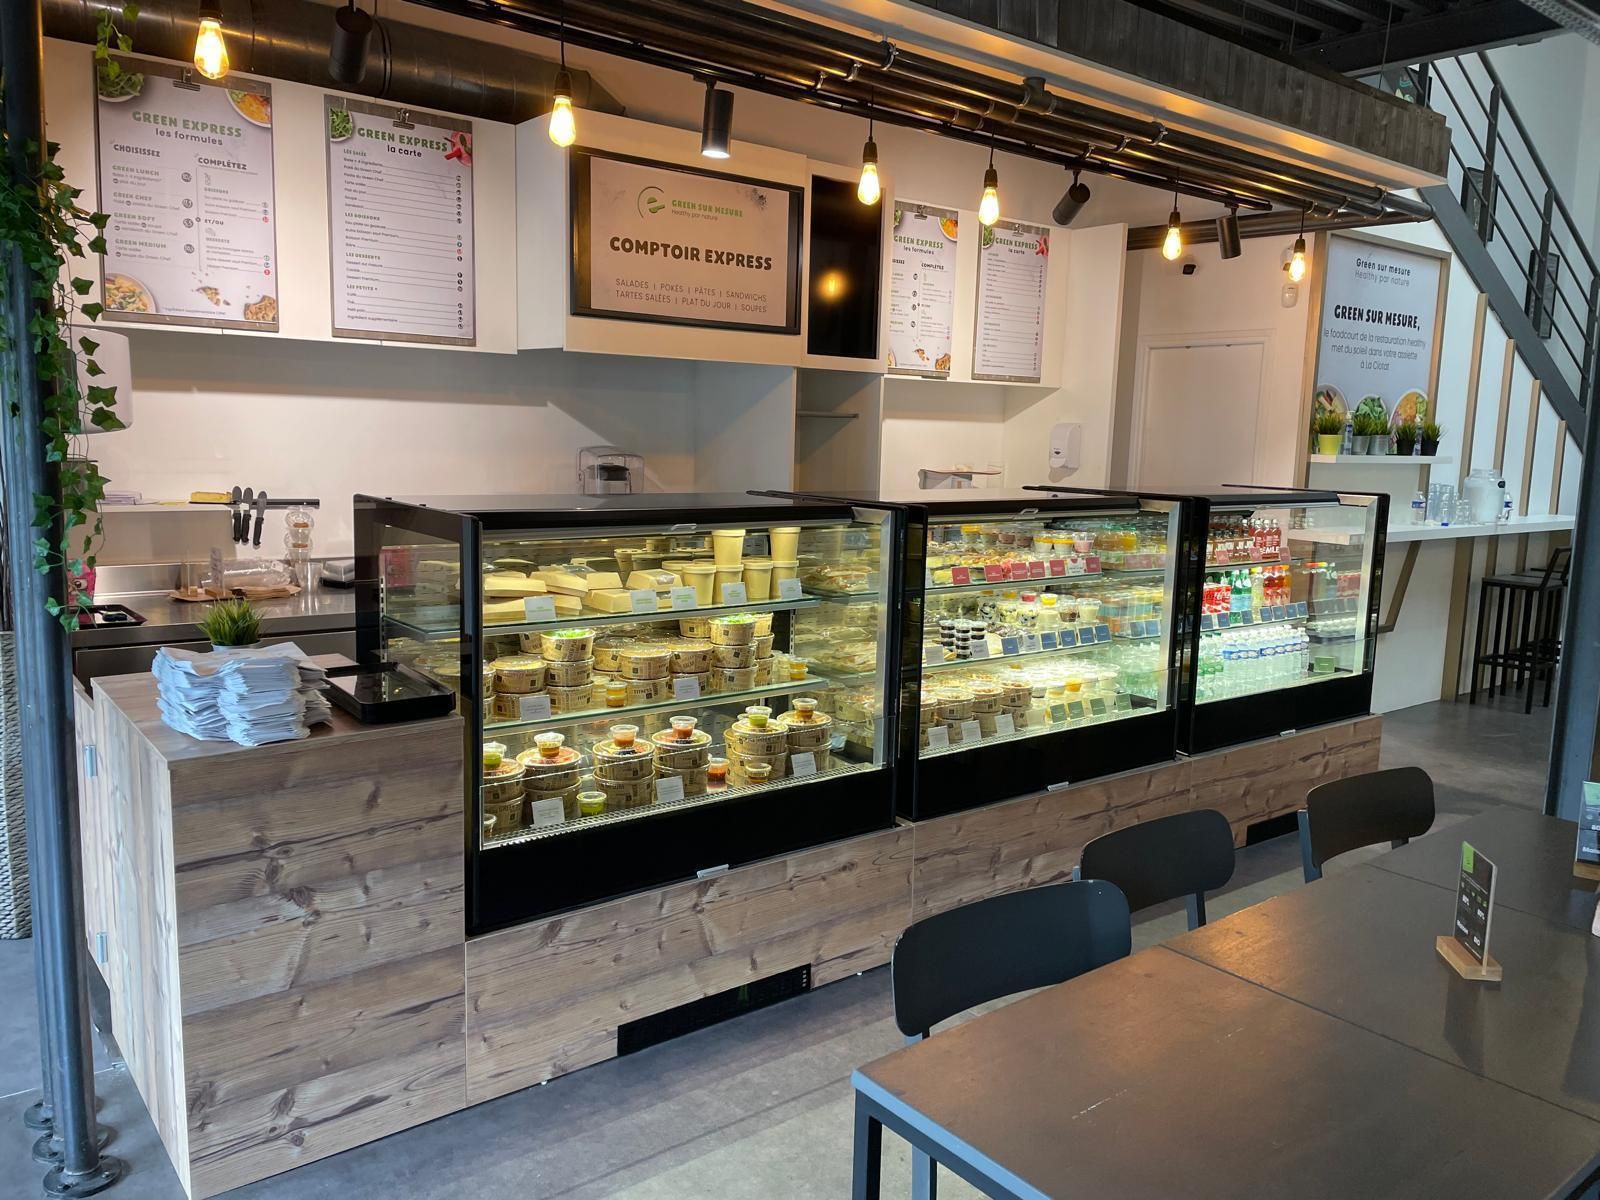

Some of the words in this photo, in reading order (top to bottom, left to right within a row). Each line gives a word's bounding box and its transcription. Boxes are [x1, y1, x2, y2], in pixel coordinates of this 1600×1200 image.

[132, 110, 178, 128] GREEN
[182, 119, 242, 138] EXPRESS
[155, 128, 171, 138] les
[174, 131, 223, 146] formules
[357, 127, 395, 142] GREEN
[399, 135, 448, 152] EXPRESS
[113, 144, 160, 158] CHOISISSEZ
[387, 145, 396, 153] la
[398, 147, 422, 158] carte
[198, 157, 247, 170] COMPLÉTEZ
[672, 200, 696, 210] GREEN
[698, 203, 713, 212] SUR
[715, 206, 743, 217] MESURE
[672, 209, 690, 217] Healthy
[894, 235, 915, 245] GREEN
[916, 239, 944, 249] EXPRESS
[912, 246, 934, 255] formules
[995, 237, 1013, 246] GREEN
[1014, 240, 1038, 250] EXPRESS
[609, 236, 700, 261] COMPTOIR
[704, 249, 772, 270] EXPRESS
[1356, 258, 1376, 270] Green
[1378, 264, 1387, 272] sur
[1389, 265, 1411, 276] mesure
[1355, 270, 1377, 283] Healthy
[1391, 277, 1410, 287] nature
[615, 278, 649, 289] SALADES
[726, 290, 767, 302] SANDWICHS
[615, 290, 643, 301] TARTES
[645, 293, 671, 304] SALÉES
[682, 297, 700, 307] PLAT
[701, 299, 711, 308] DU
[713, 301, 731, 309] JOUR
[741, 304, 767, 313] SOUPES
[1334, 304, 1363, 321] GREEN
[1366, 309, 1383, 325] SUR
[1385, 312, 1420, 331] MESURE,
[1324, 328, 1329, 337] le
[1330, 328, 1359, 340] foodcourt
[1360, 332, 1367, 341] de
[1368, 333, 1374, 342] la
[1374, 335, 1406, 345] restauration
[1331, 344, 1344, 352] met
[1344, 346, 1352, 354] du
[1353, 346, 1367, 355] soleil
[1369, 348, 1382, 356] dans
[1383, 350, 1396, 358] votre
